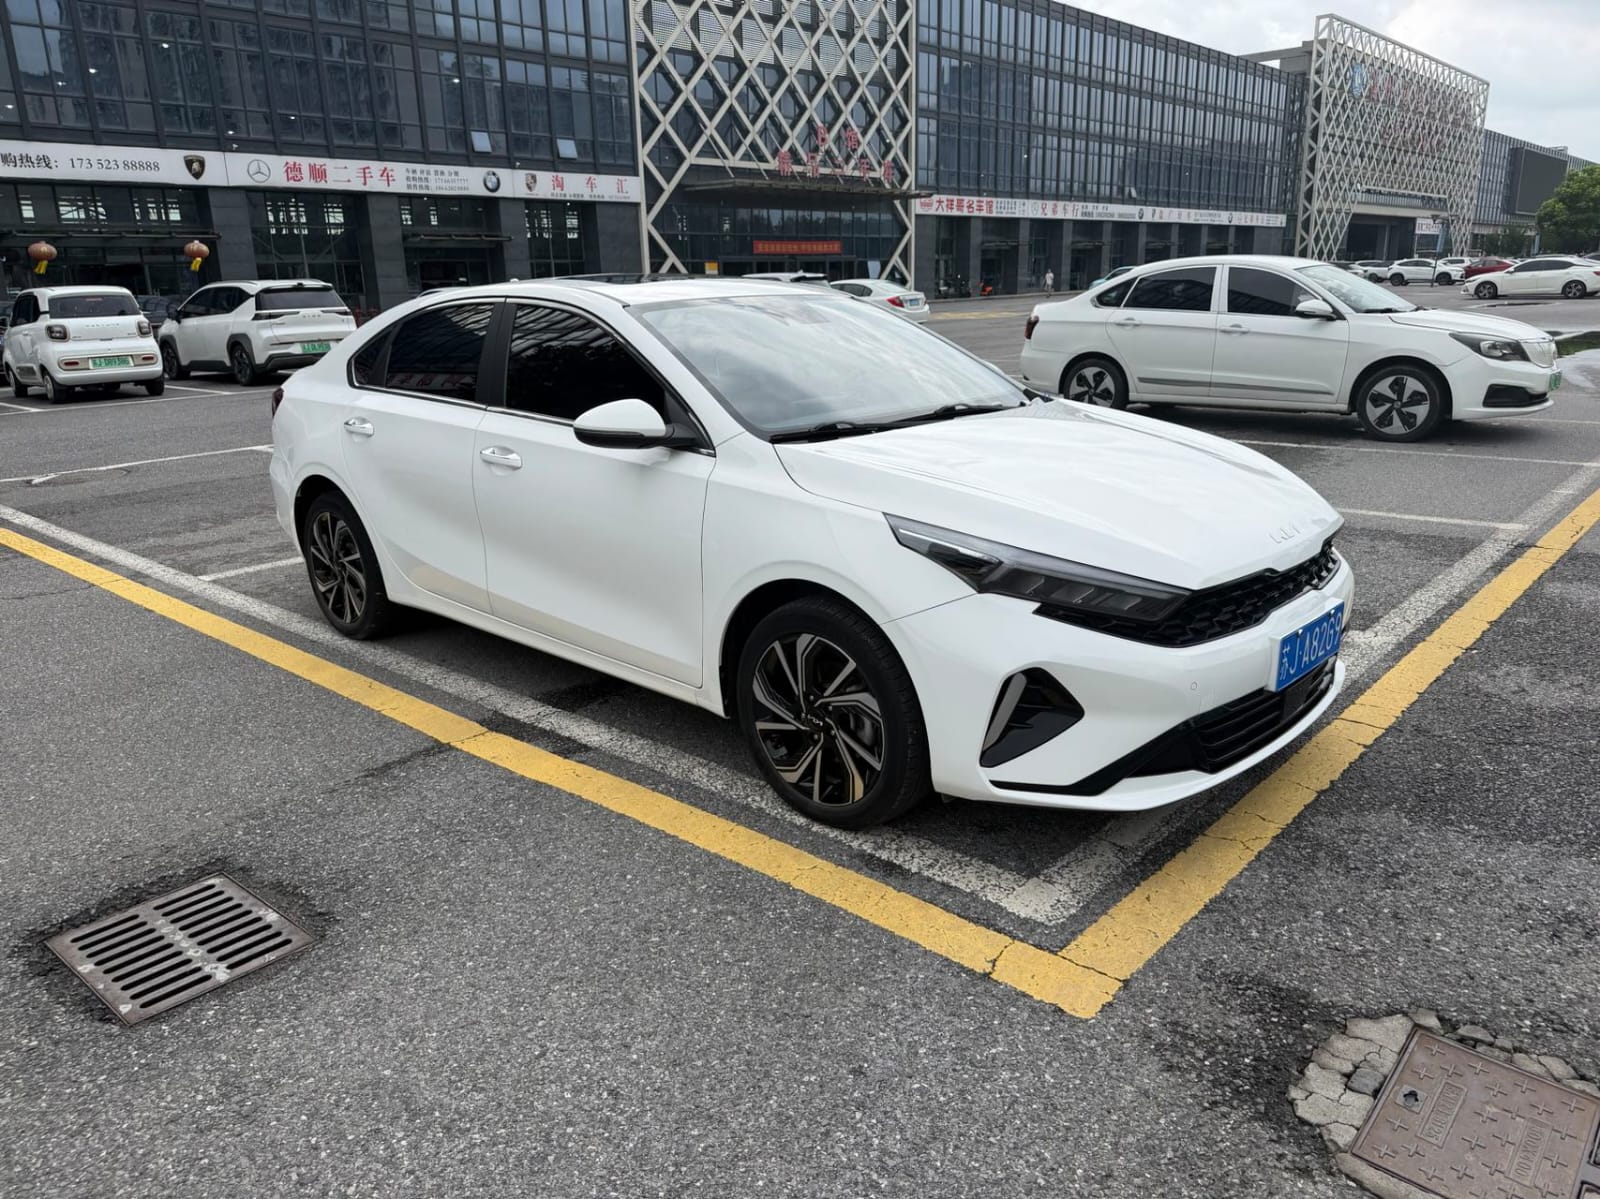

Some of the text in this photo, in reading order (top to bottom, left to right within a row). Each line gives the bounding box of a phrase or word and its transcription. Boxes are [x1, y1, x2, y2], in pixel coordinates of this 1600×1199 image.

[69, 158, 92, 169] 173
[97, 158, 119, 170] 523
[123, 160, 160, 171] 88888
[283, 160, 396, 187] 德顺二手车
[552, 175, 629, 194] 淘车汇
